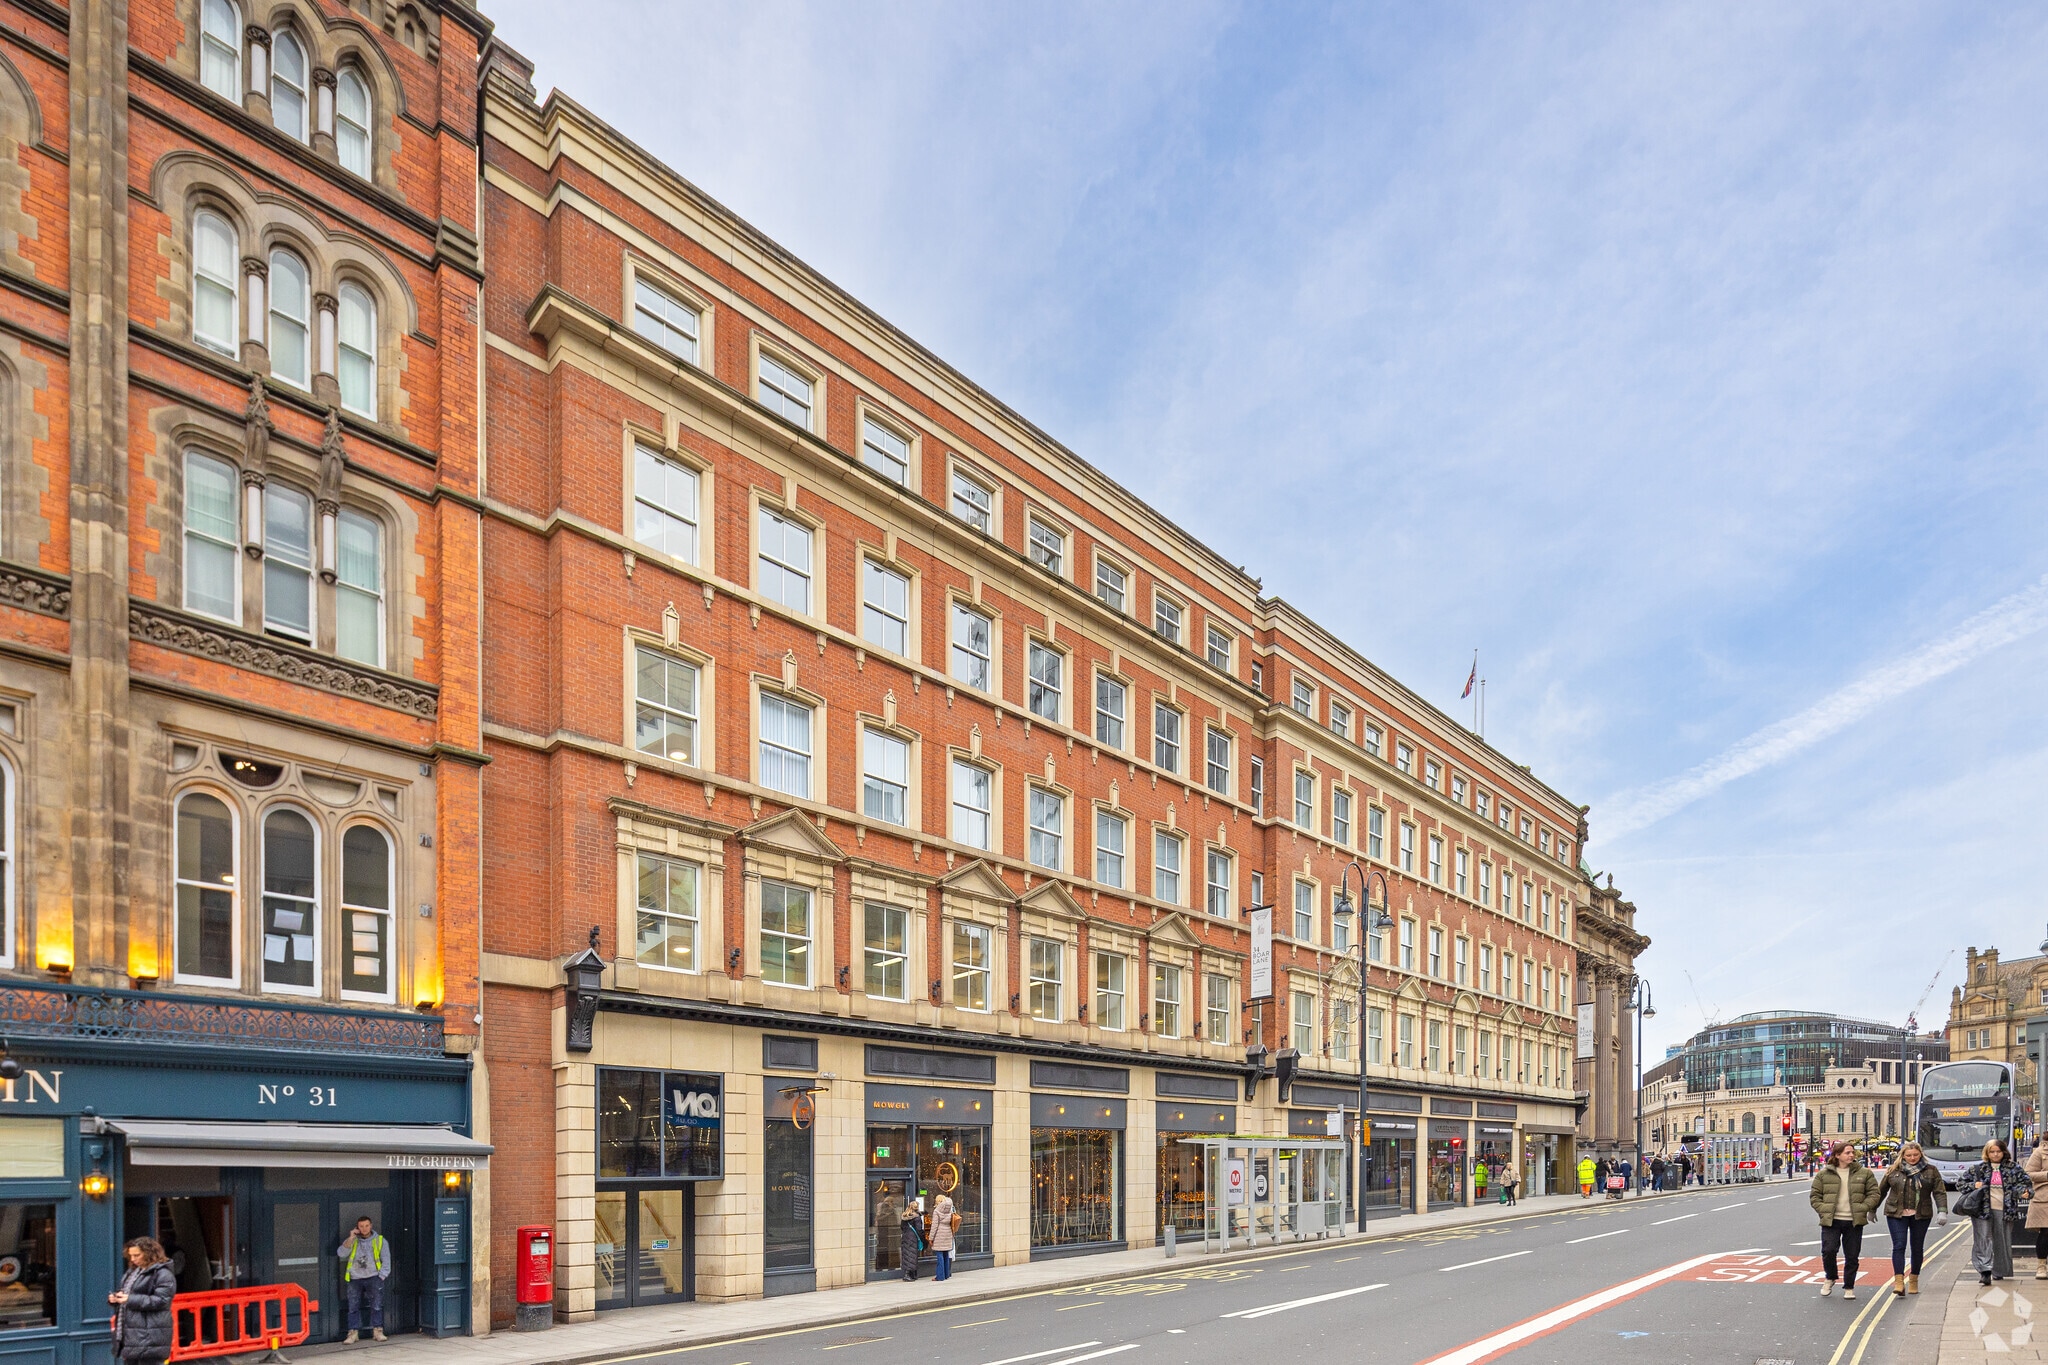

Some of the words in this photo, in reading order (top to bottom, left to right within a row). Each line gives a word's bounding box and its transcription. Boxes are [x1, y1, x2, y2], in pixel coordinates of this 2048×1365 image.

[1252, 950, 1270, 959] BOAR
[1253, 957, 1269, 965] LANE
[309, 1086, 337, 1106] 31
[873, 1101, 910, 1109] MOWGLI
[1978, 1105, 1995, 1116] 7A
[386, 1154, 416, 1167] THE
[420, 1156, 475, 1168] GRIFFIN
[1696, 1267, 1869, 1285] BUS
